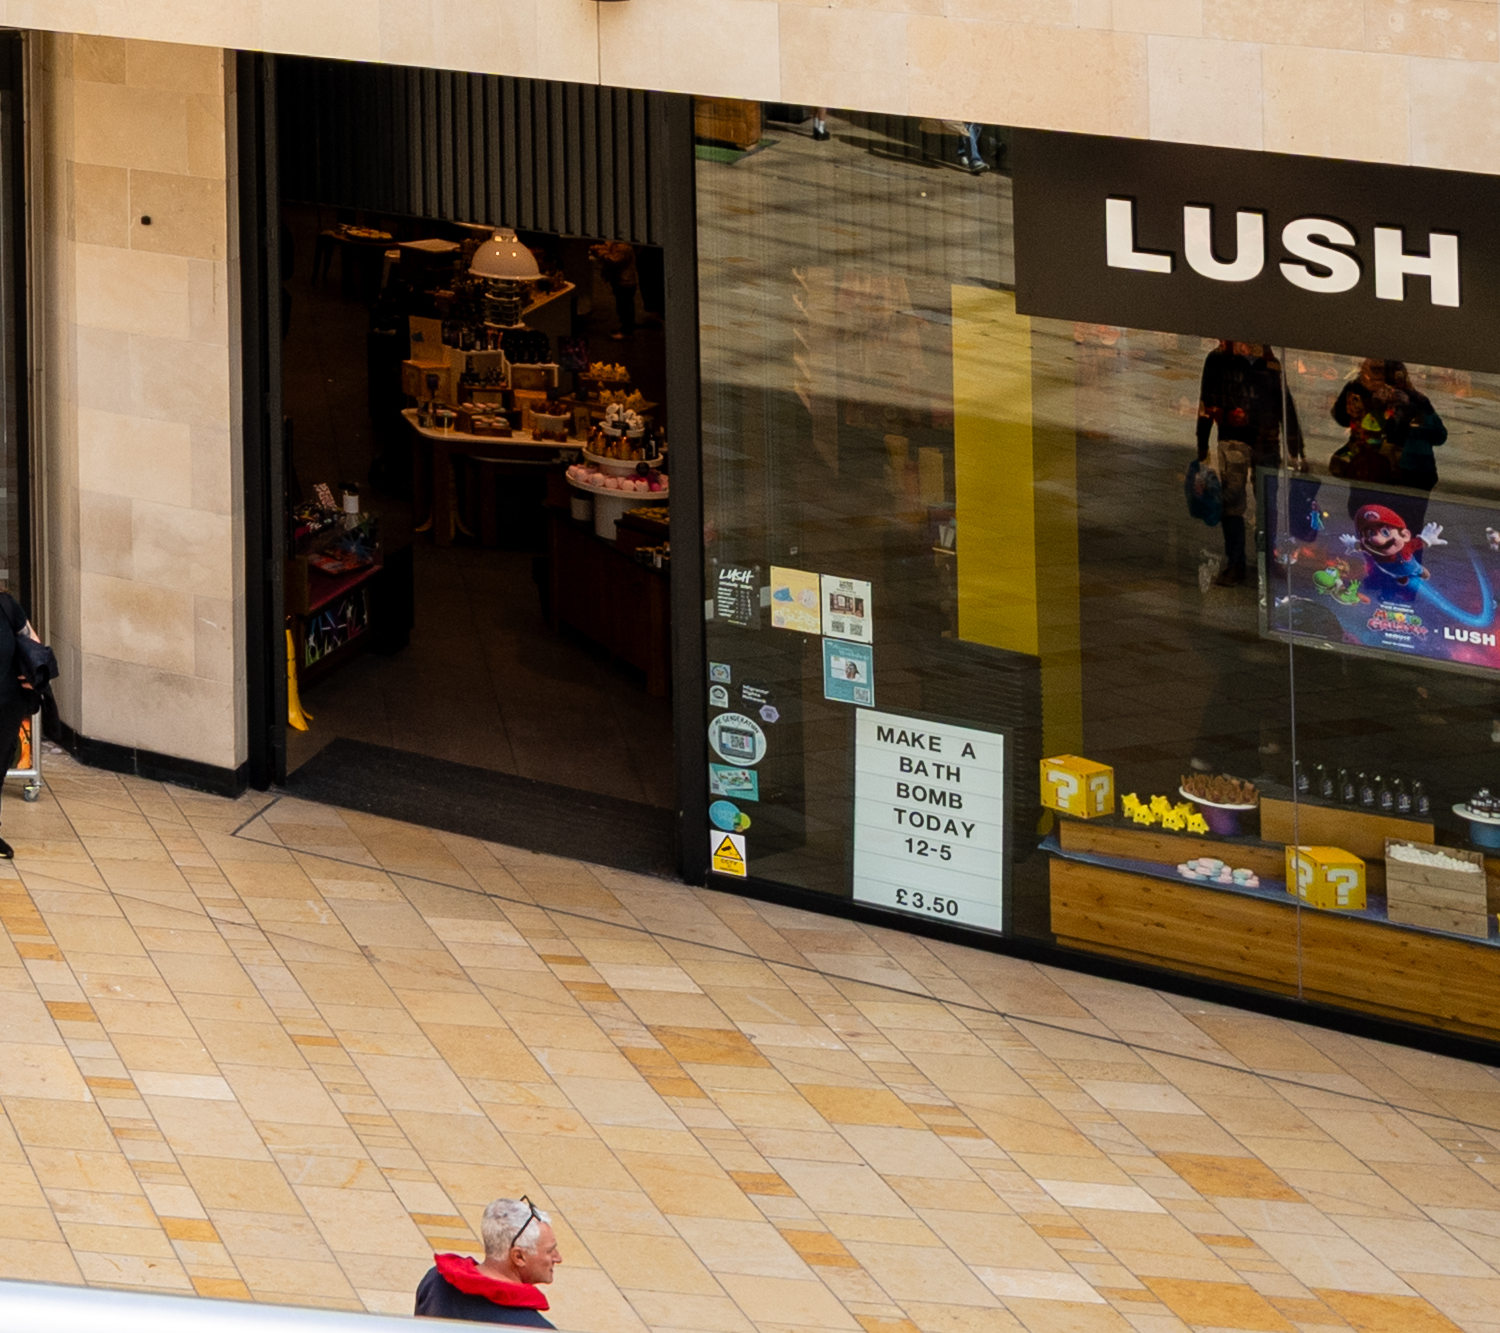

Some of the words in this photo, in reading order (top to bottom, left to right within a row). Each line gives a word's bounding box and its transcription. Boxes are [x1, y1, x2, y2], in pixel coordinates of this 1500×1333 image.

[1105, 198, 1460, 308] LUSH
[719, 568, 755, 584] LUSH
[1444, 627, 1496, 646] LUSH
[877, 726, 942, 753] MAKE
[961, 743, 976, 759] A
[900, 756, 960, 782] BATH
[897, 782, 963, 809] BOMB
[894, 808, 975, 838] TODAY
[905, 837, 952, 861] 12-5
[896, 889, 958, 916] £3.50
